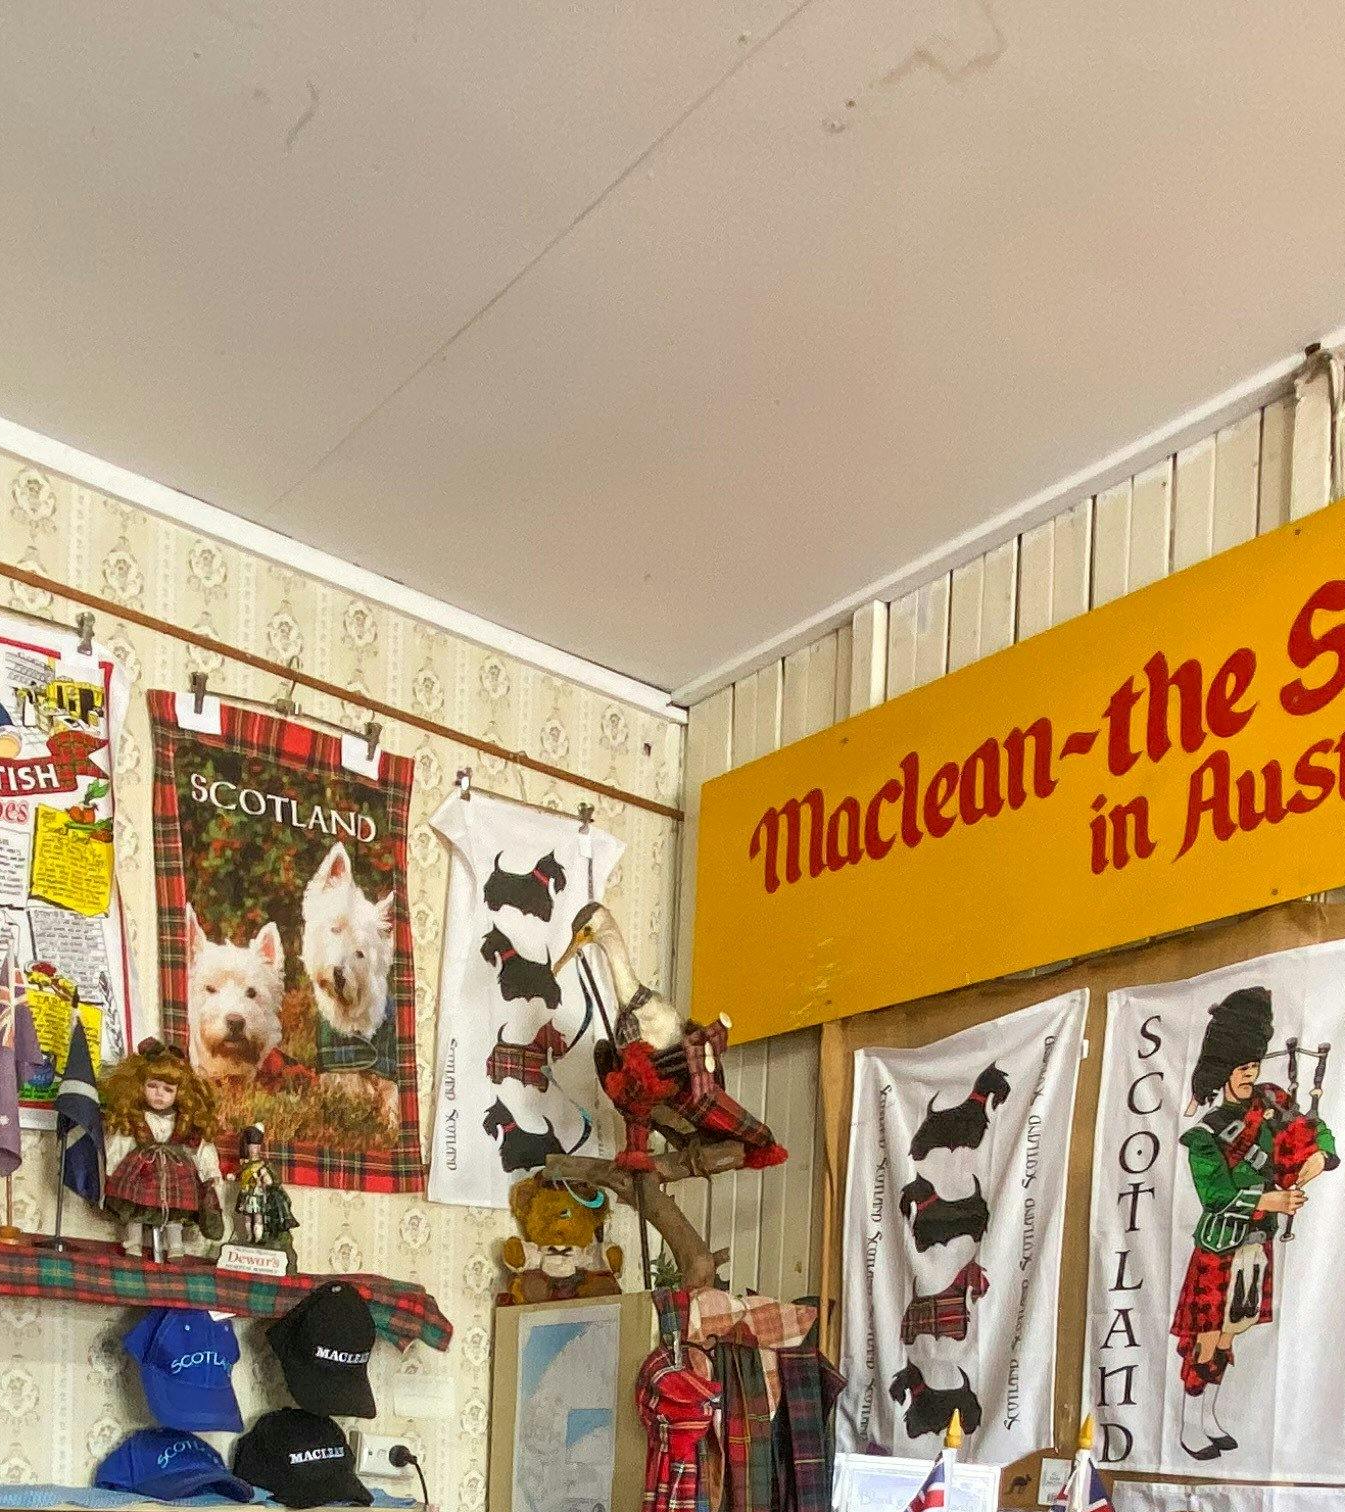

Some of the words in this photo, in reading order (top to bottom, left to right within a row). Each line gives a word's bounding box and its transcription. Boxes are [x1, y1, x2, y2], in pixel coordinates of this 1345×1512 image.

[190, 773, 377, 843] SCOTLAND
[1090, 794, 1155, 875] in
[1097, 1016, 1161, 1464] SCOTLAND
